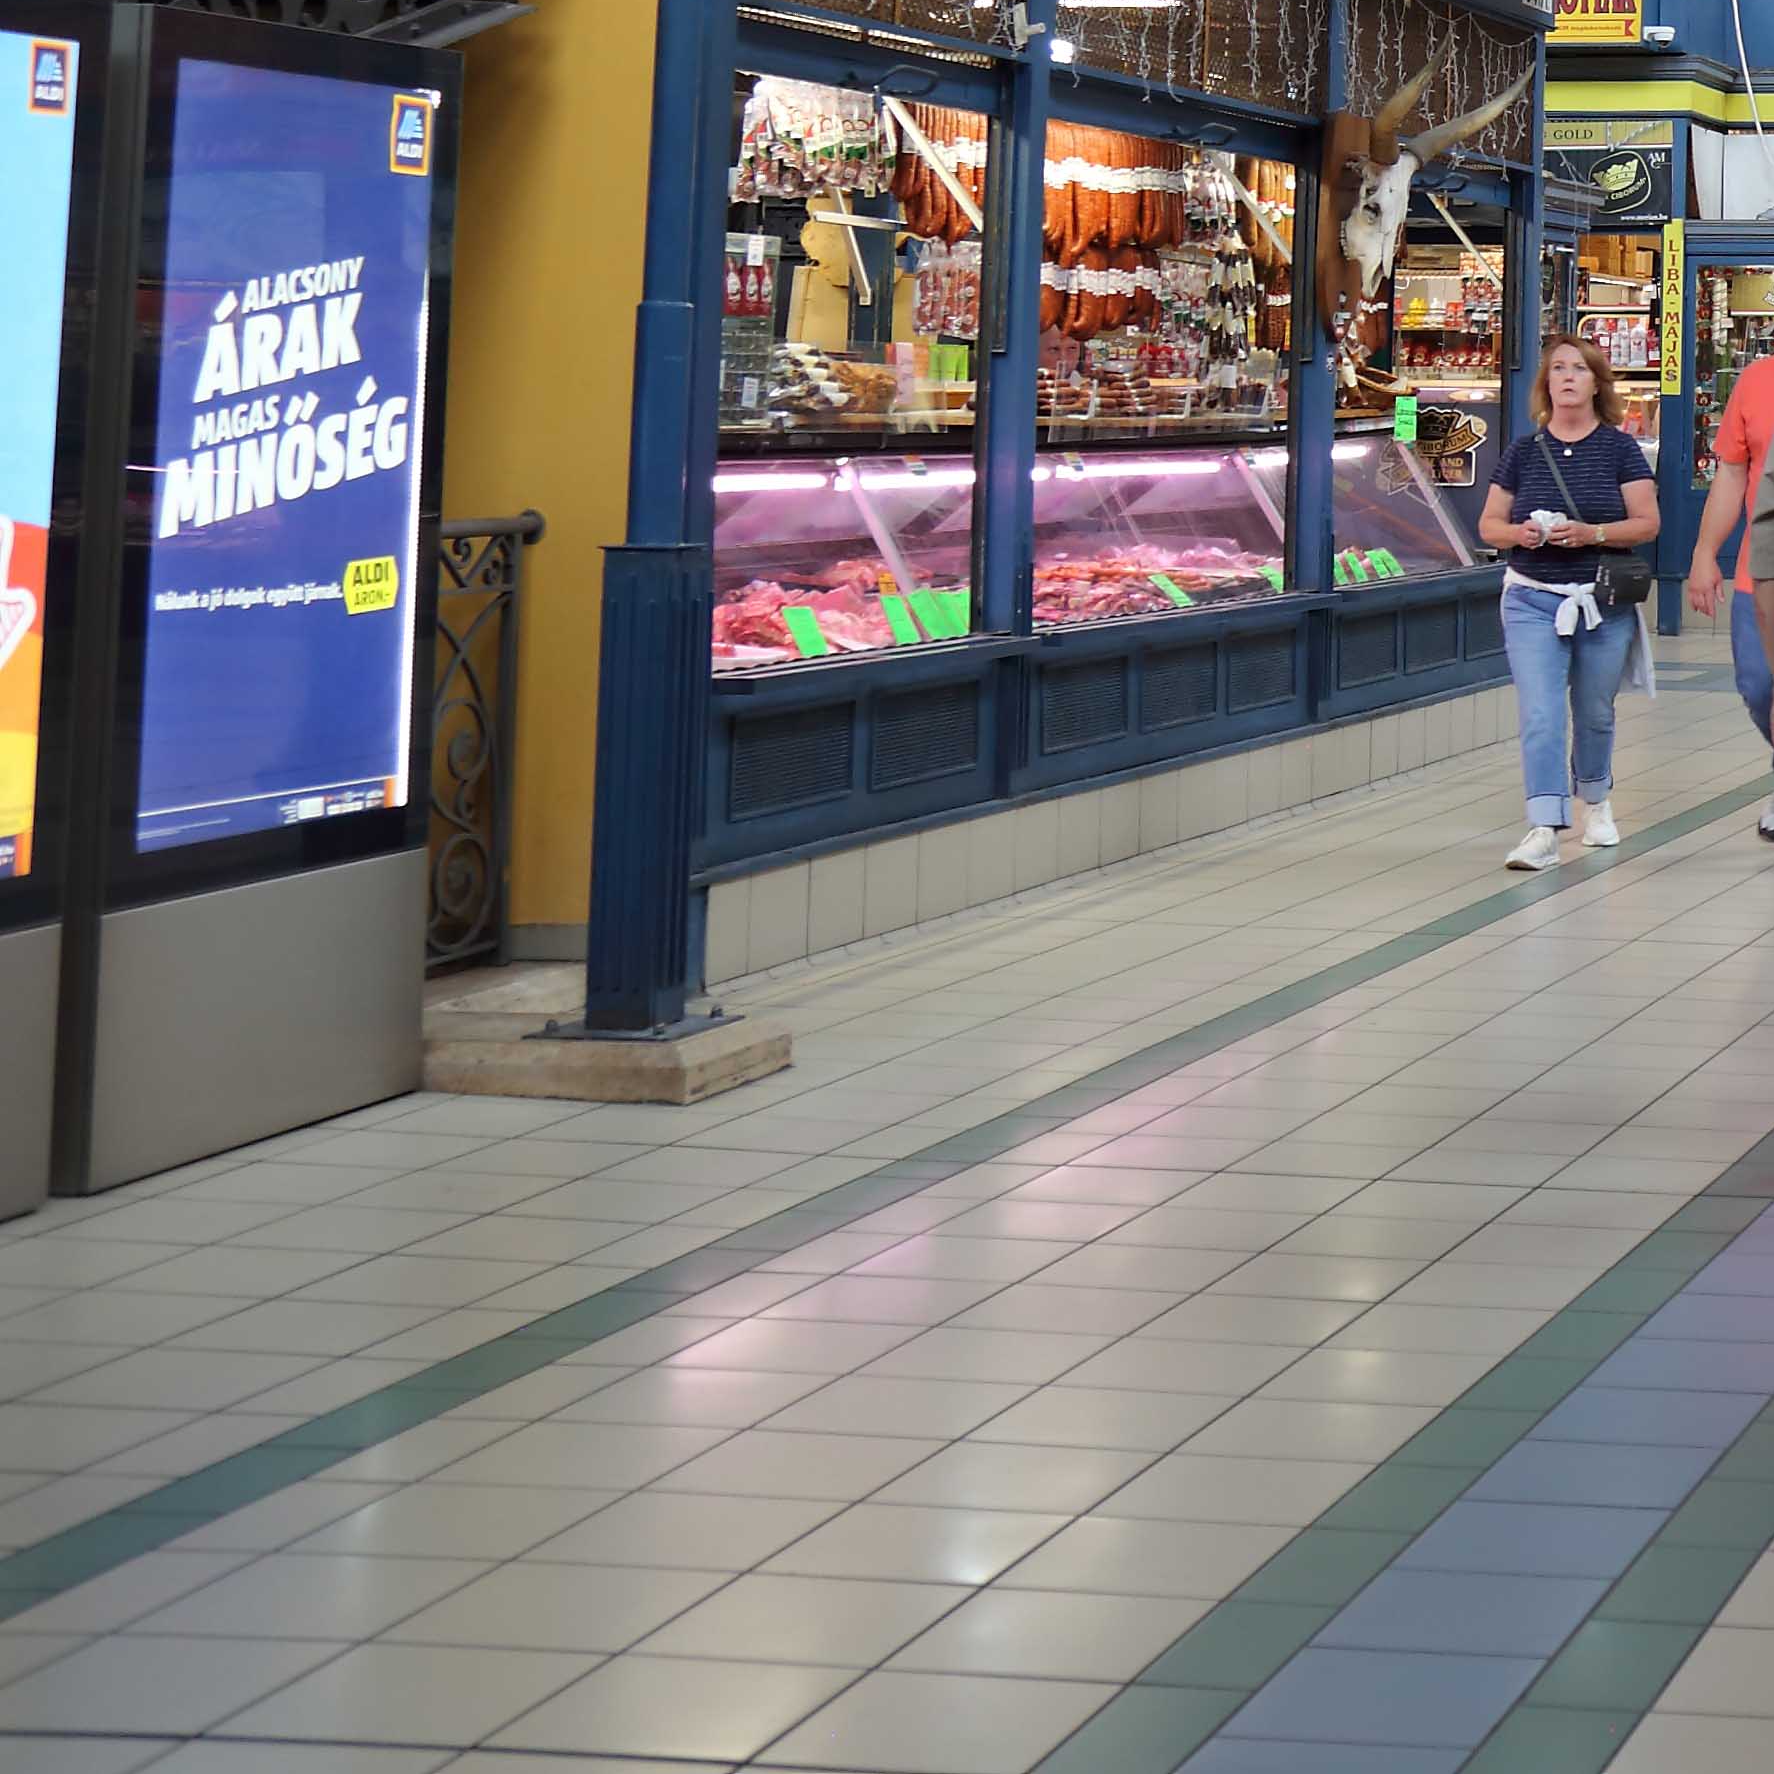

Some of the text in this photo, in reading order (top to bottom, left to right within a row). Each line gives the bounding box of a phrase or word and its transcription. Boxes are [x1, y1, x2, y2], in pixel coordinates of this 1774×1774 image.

[1553, 129, 1593, 140] GOLD
[241, 256, 366, 314] ALACSONY
[193, 290, 363, 404] ÁRAK
[191, 394, 281, 451] MAGAS
[158, 375, 409, 539] MINŐSÉG
[352, 561, 390, 587] ALDI
